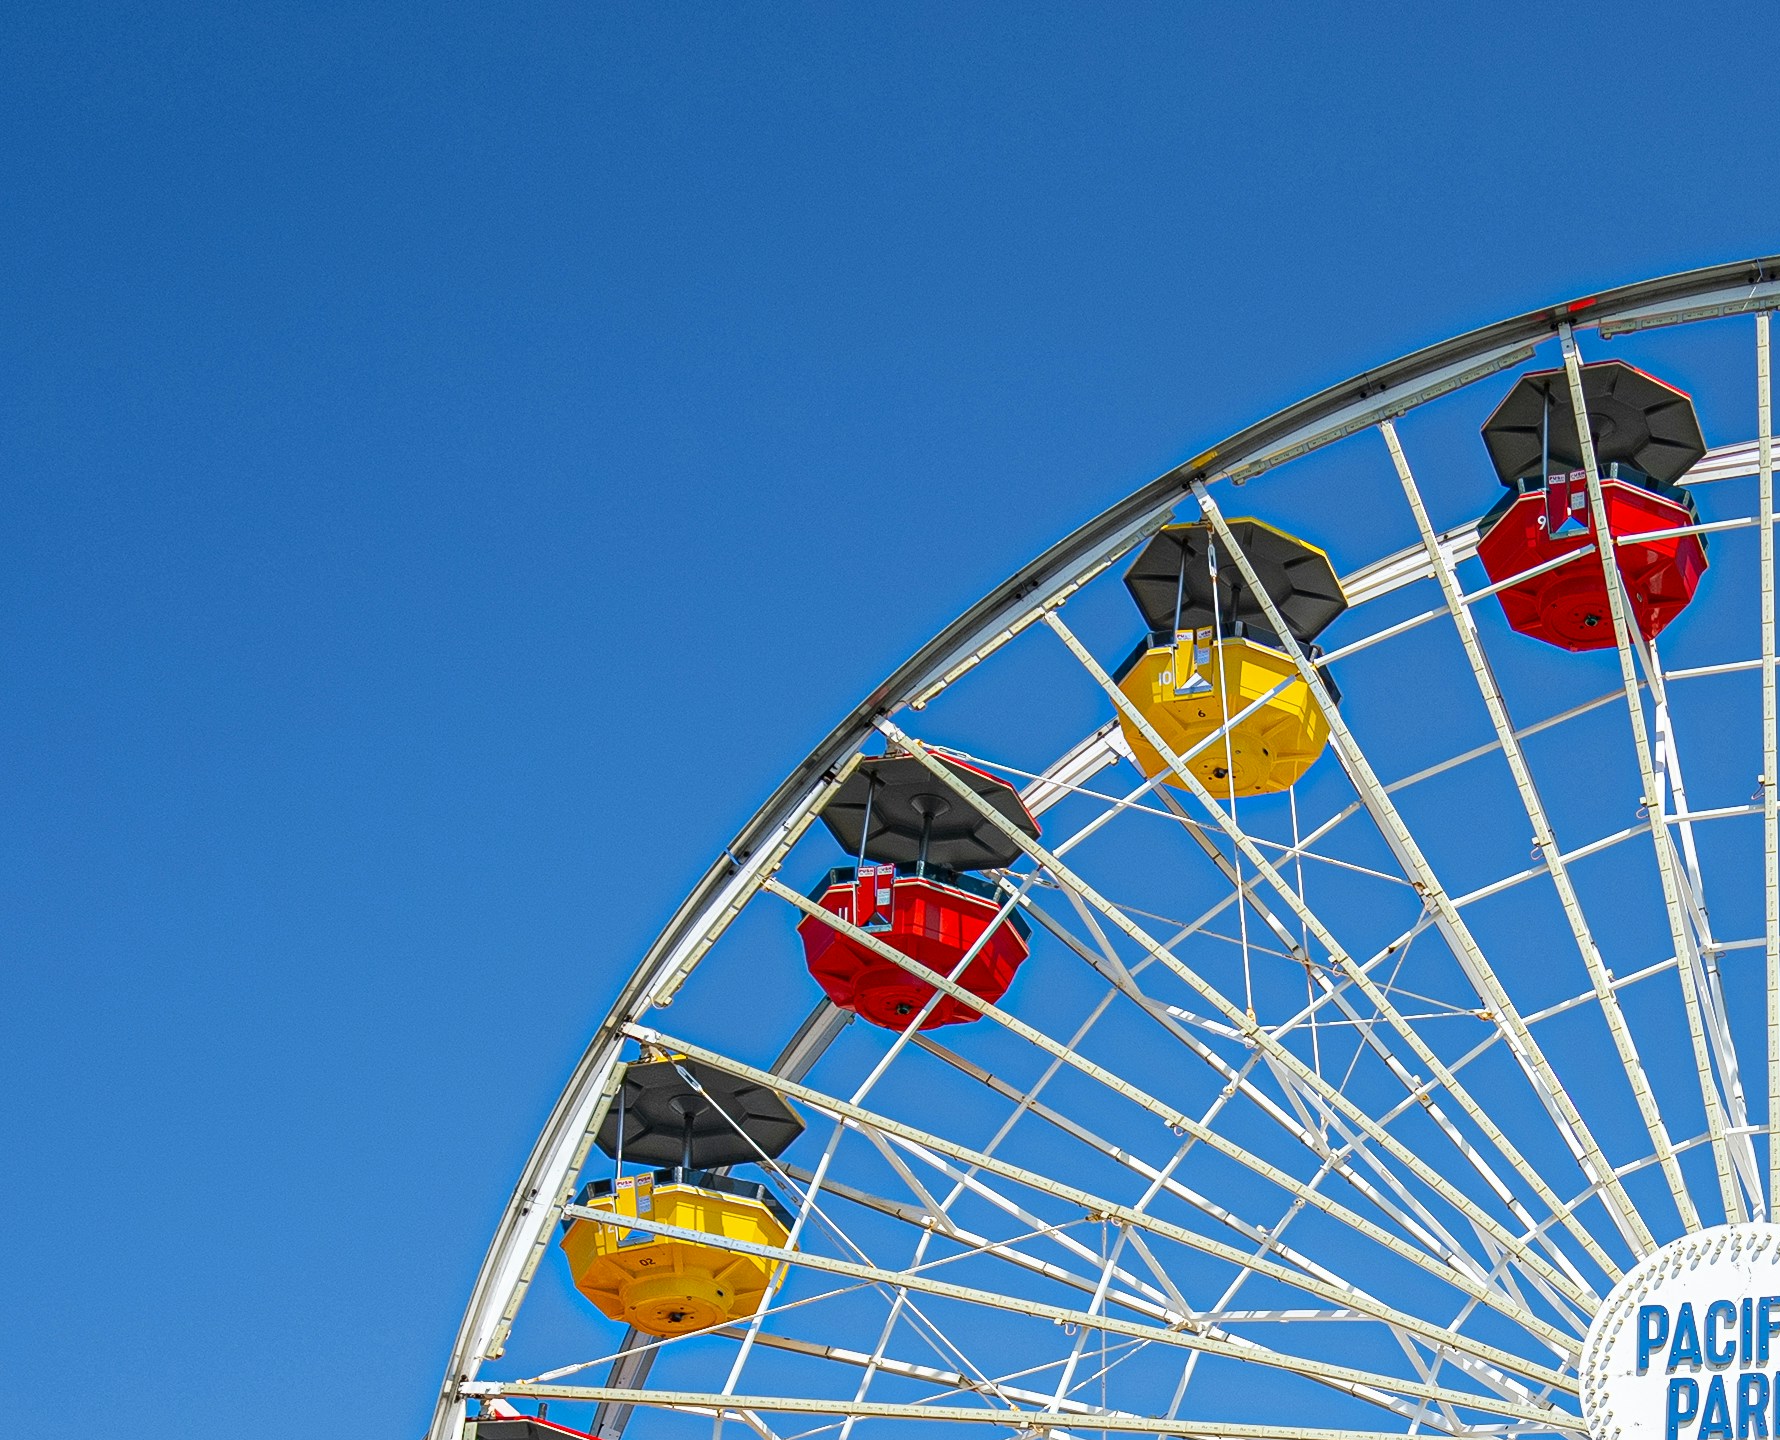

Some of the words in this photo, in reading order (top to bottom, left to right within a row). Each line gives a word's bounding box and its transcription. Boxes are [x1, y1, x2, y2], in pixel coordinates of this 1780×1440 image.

[1537, 515, 1546, 530] 9
[1158, 671, 1172, 686] 10
[1198, 710, 1206, 718] 6
[639, 1258, 656, 1266] 02
